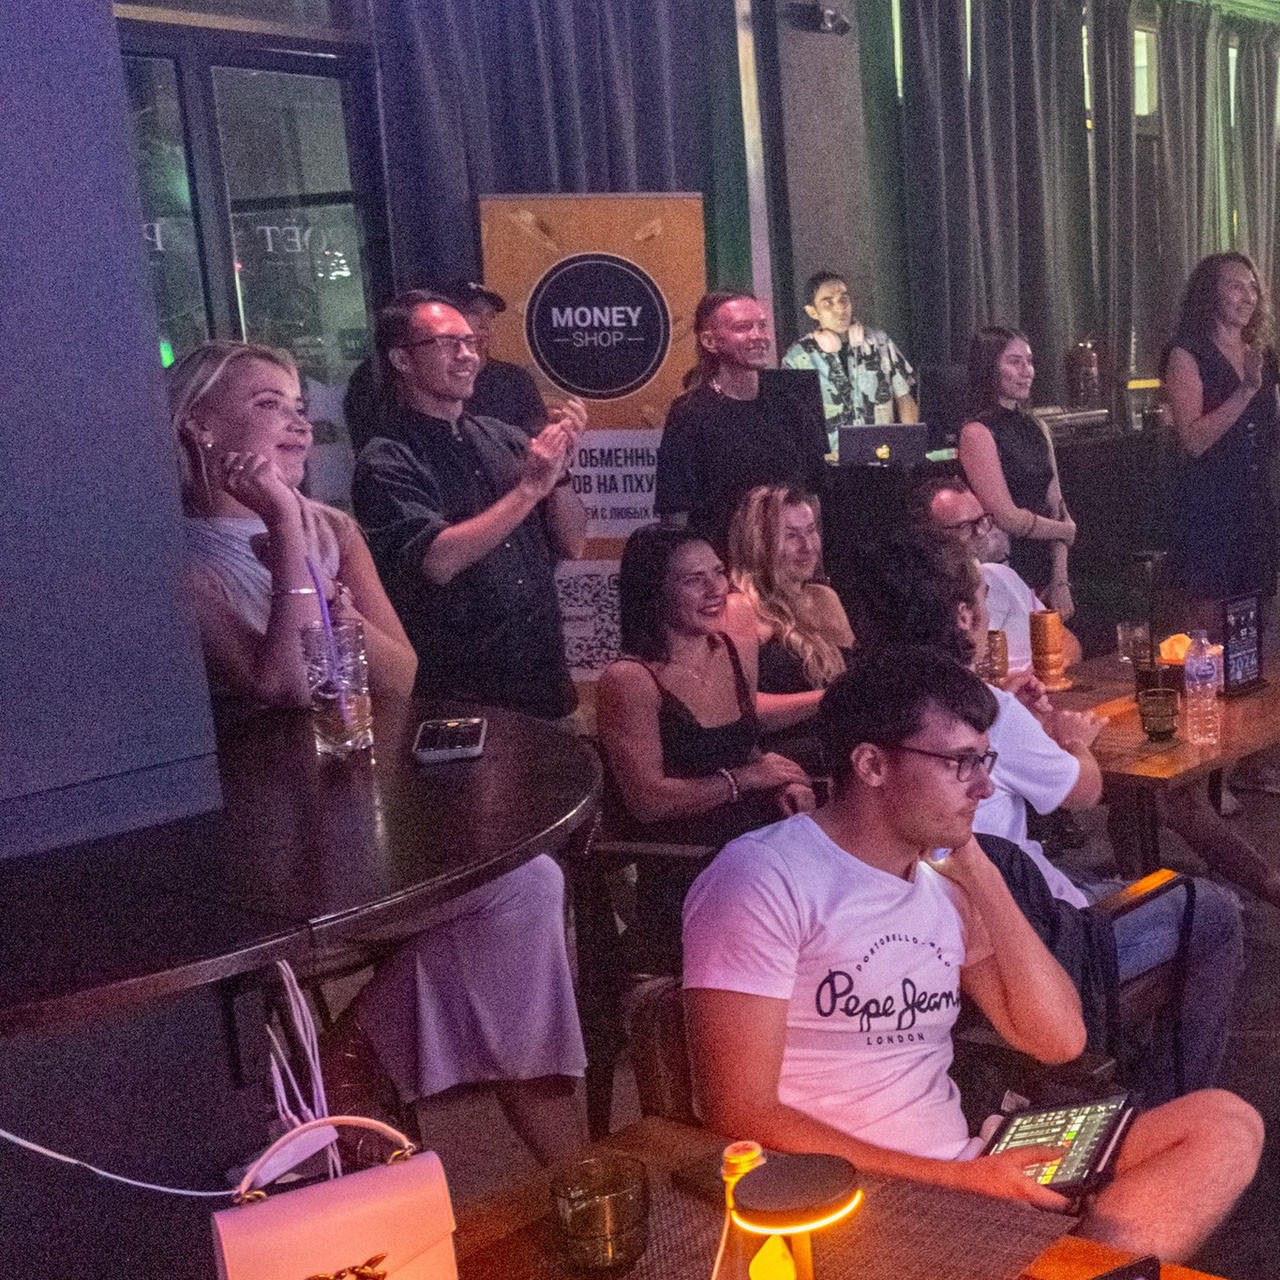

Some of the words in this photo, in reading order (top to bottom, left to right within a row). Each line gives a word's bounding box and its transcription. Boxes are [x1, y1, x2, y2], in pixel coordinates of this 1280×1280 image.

[551, 306, 643, 328] MONEY
[572, 330, 624, 348] SHOP
[597, 474, 619, 494] НА
[815, 968, 896, 1033] Pepe
[866, 1032, 925, 1046] LONDON
